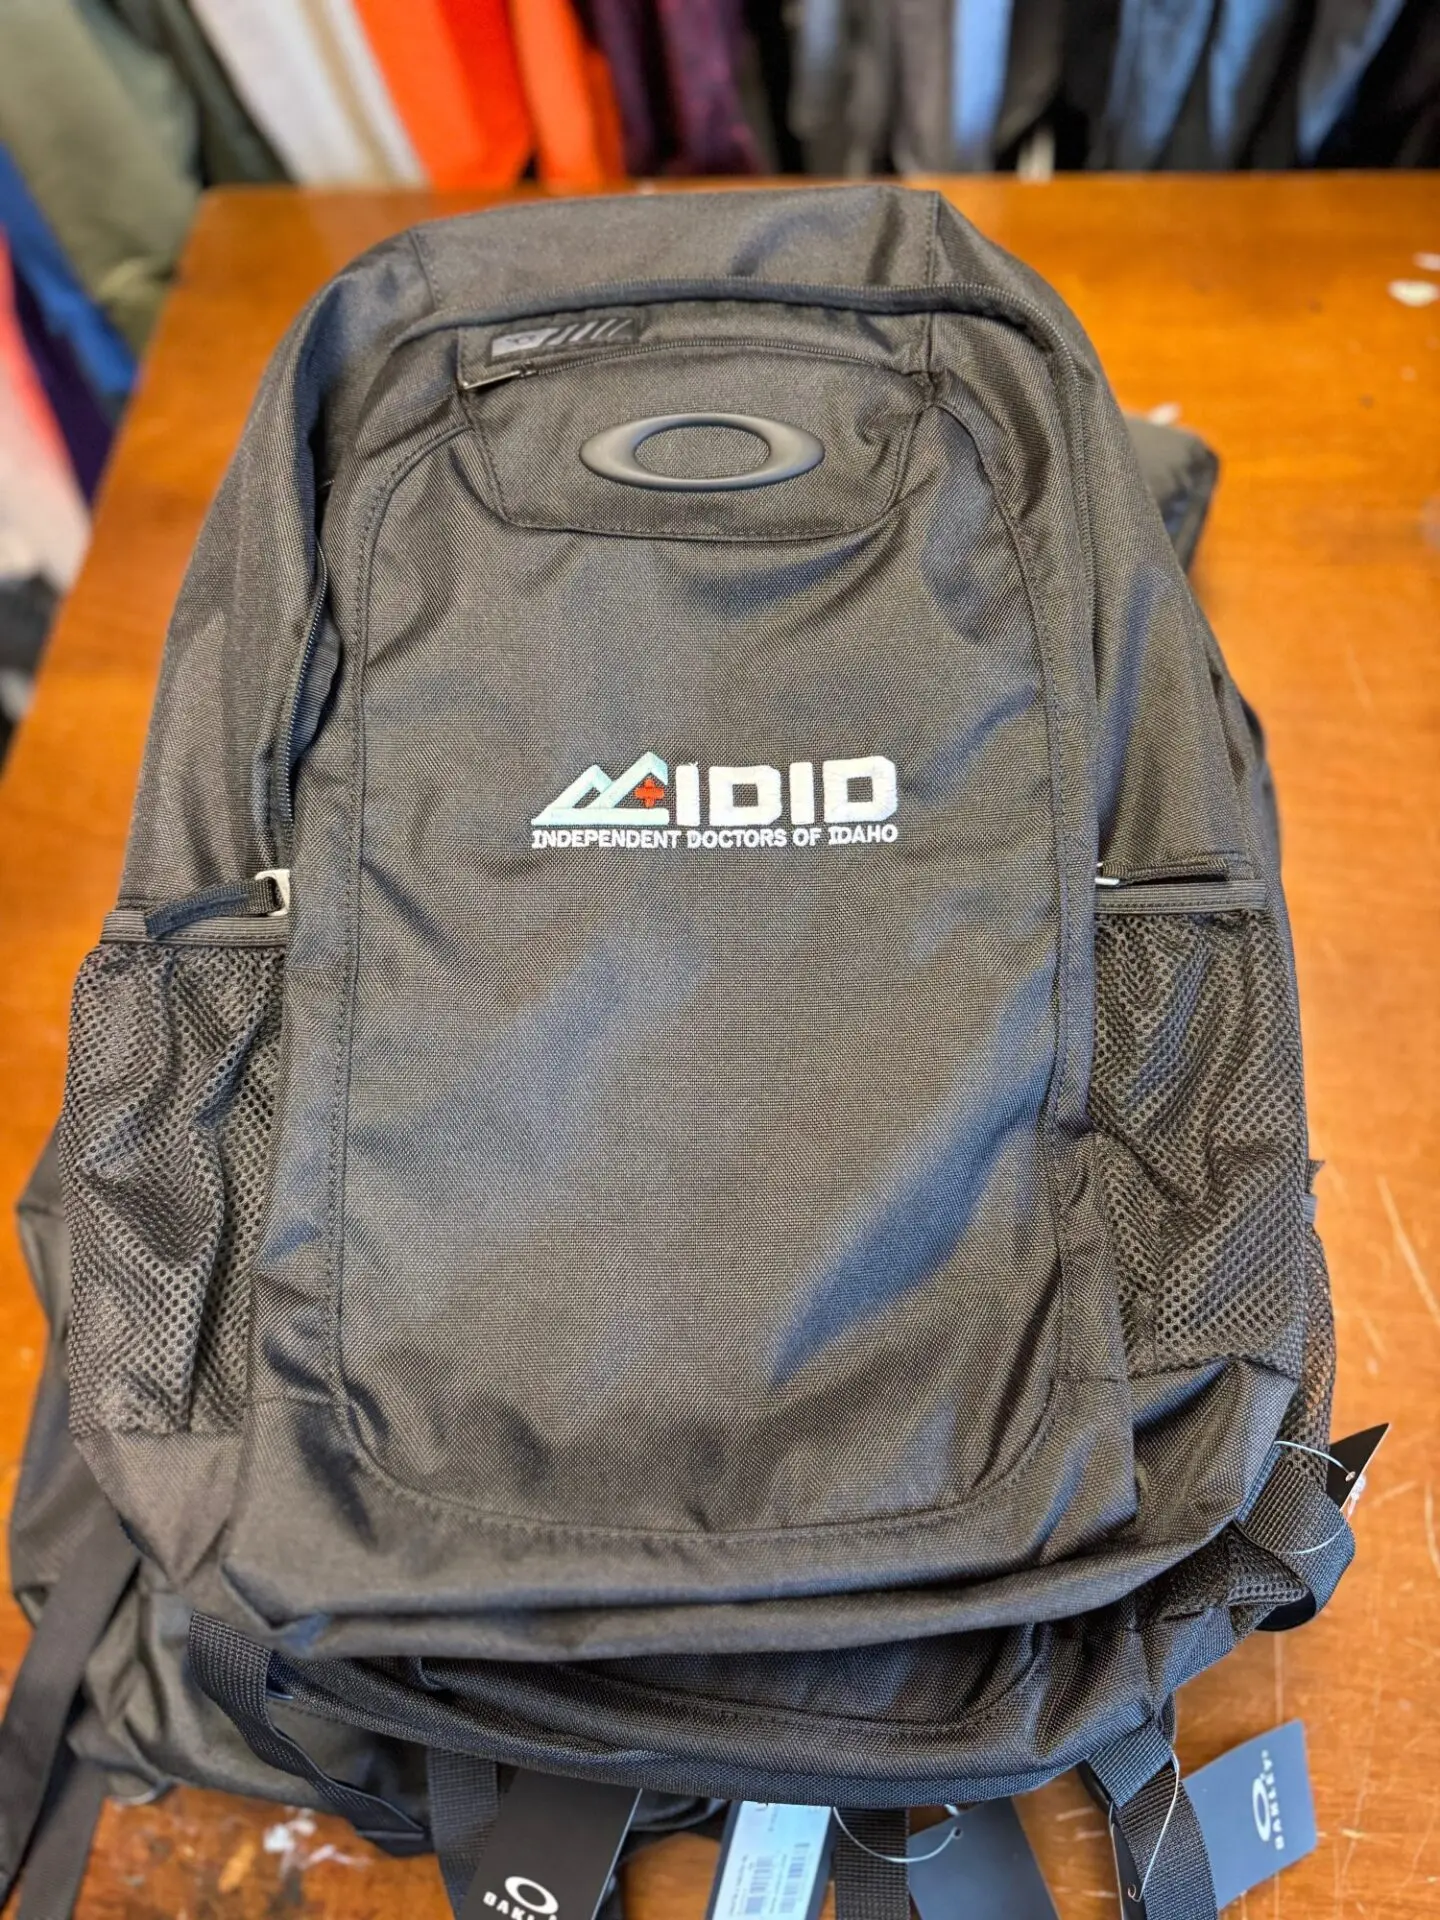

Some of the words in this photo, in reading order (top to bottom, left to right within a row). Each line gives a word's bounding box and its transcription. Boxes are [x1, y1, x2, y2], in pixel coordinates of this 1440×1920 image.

[675, 755, 898, 826] IDID
[531, 829, 682, 849] INDEPENDENT
[687, 828, 788, 848] DOCTORS
[791, 826, 821, 847] OF
[828, 823, 899, 845] IDAHO
